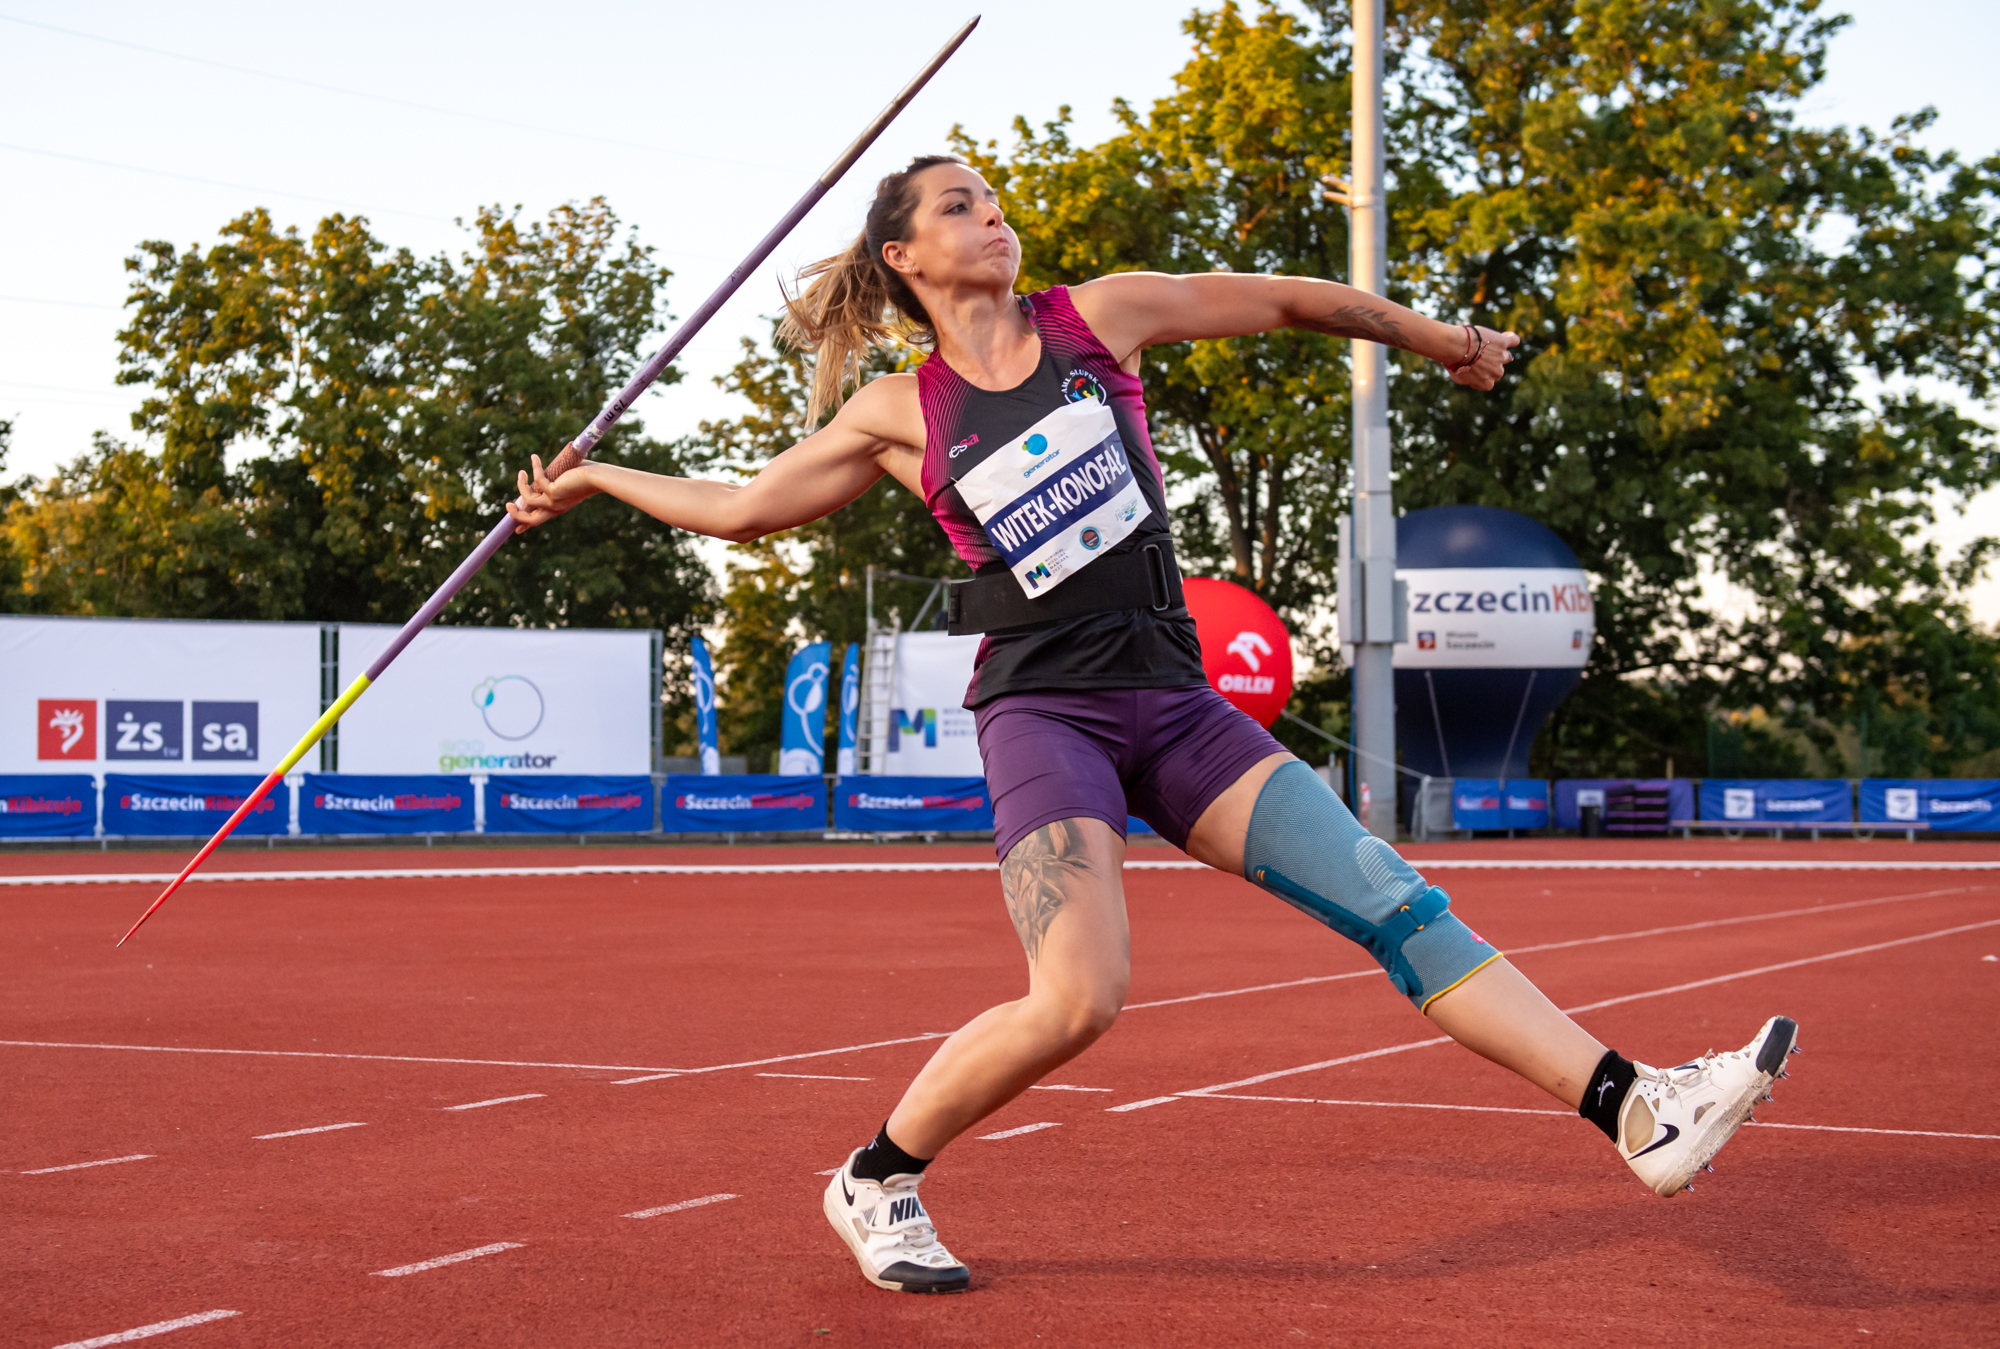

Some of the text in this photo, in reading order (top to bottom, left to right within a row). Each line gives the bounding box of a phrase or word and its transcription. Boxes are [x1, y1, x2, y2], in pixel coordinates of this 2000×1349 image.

[604, 399, 628, 422] 75 m
[1023, 448, 1061, 479] generator
[991, 444, 1127, 553] WITEK-KONOFAŁ
[1218, 673, 1275, 694] ORLEN
[202, 722, 249, 752] sa
[439, 752, 557, 774] generator
[120, 794, 275, 814] #SzczecinKibije
[315, 793, 461, 812] #SzczecinKibicuje
[500, 792, 642, 812] #SzczecinKibicuje
[888, 1196, 927, 1226] NIK
